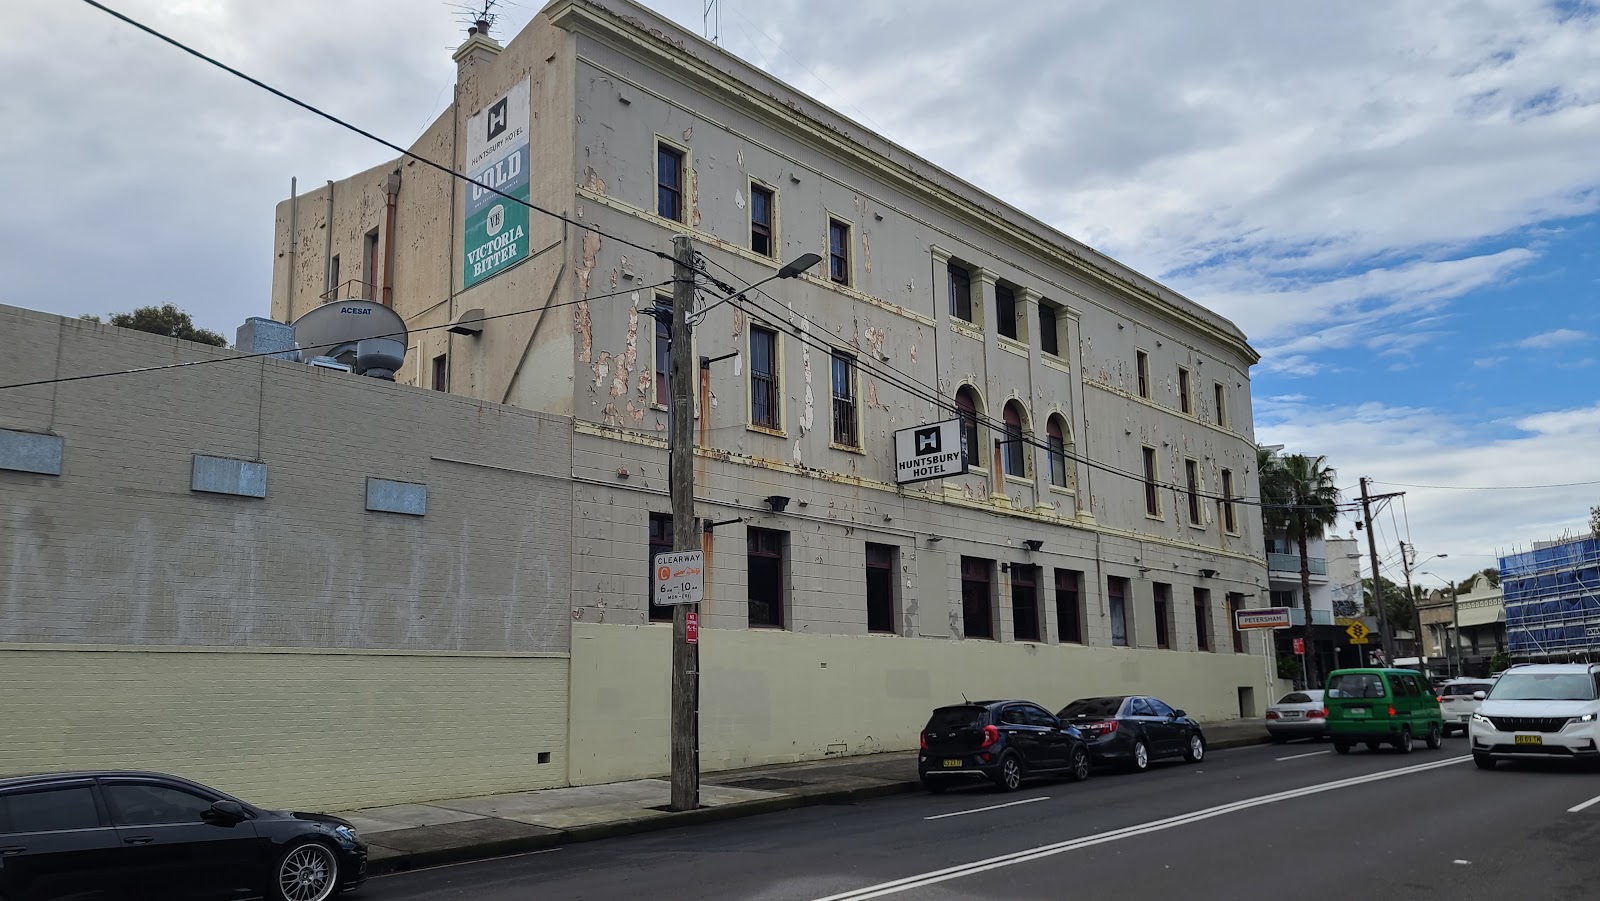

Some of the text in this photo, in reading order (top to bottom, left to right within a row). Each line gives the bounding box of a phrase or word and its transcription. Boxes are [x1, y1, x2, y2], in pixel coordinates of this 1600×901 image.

[504, 126, 523, 144] HOTEL
[472, 150, 521, 201] COLD
[489, 212, 501, 229] VB
[467, 224, 525, 265] VICTORIA
[473, 242, 517, 278] BITTER
[341, 307, 372, 315] ACESAT
[919, 431, 937, 452] H
[899, 451, 960, 470] HUNTSBURY
[913, 464, 946, 477] HOTEL
[657, 554, 701, 565] CLEARWAY
[1244, 615, 1282, 624] PETERSHAM
